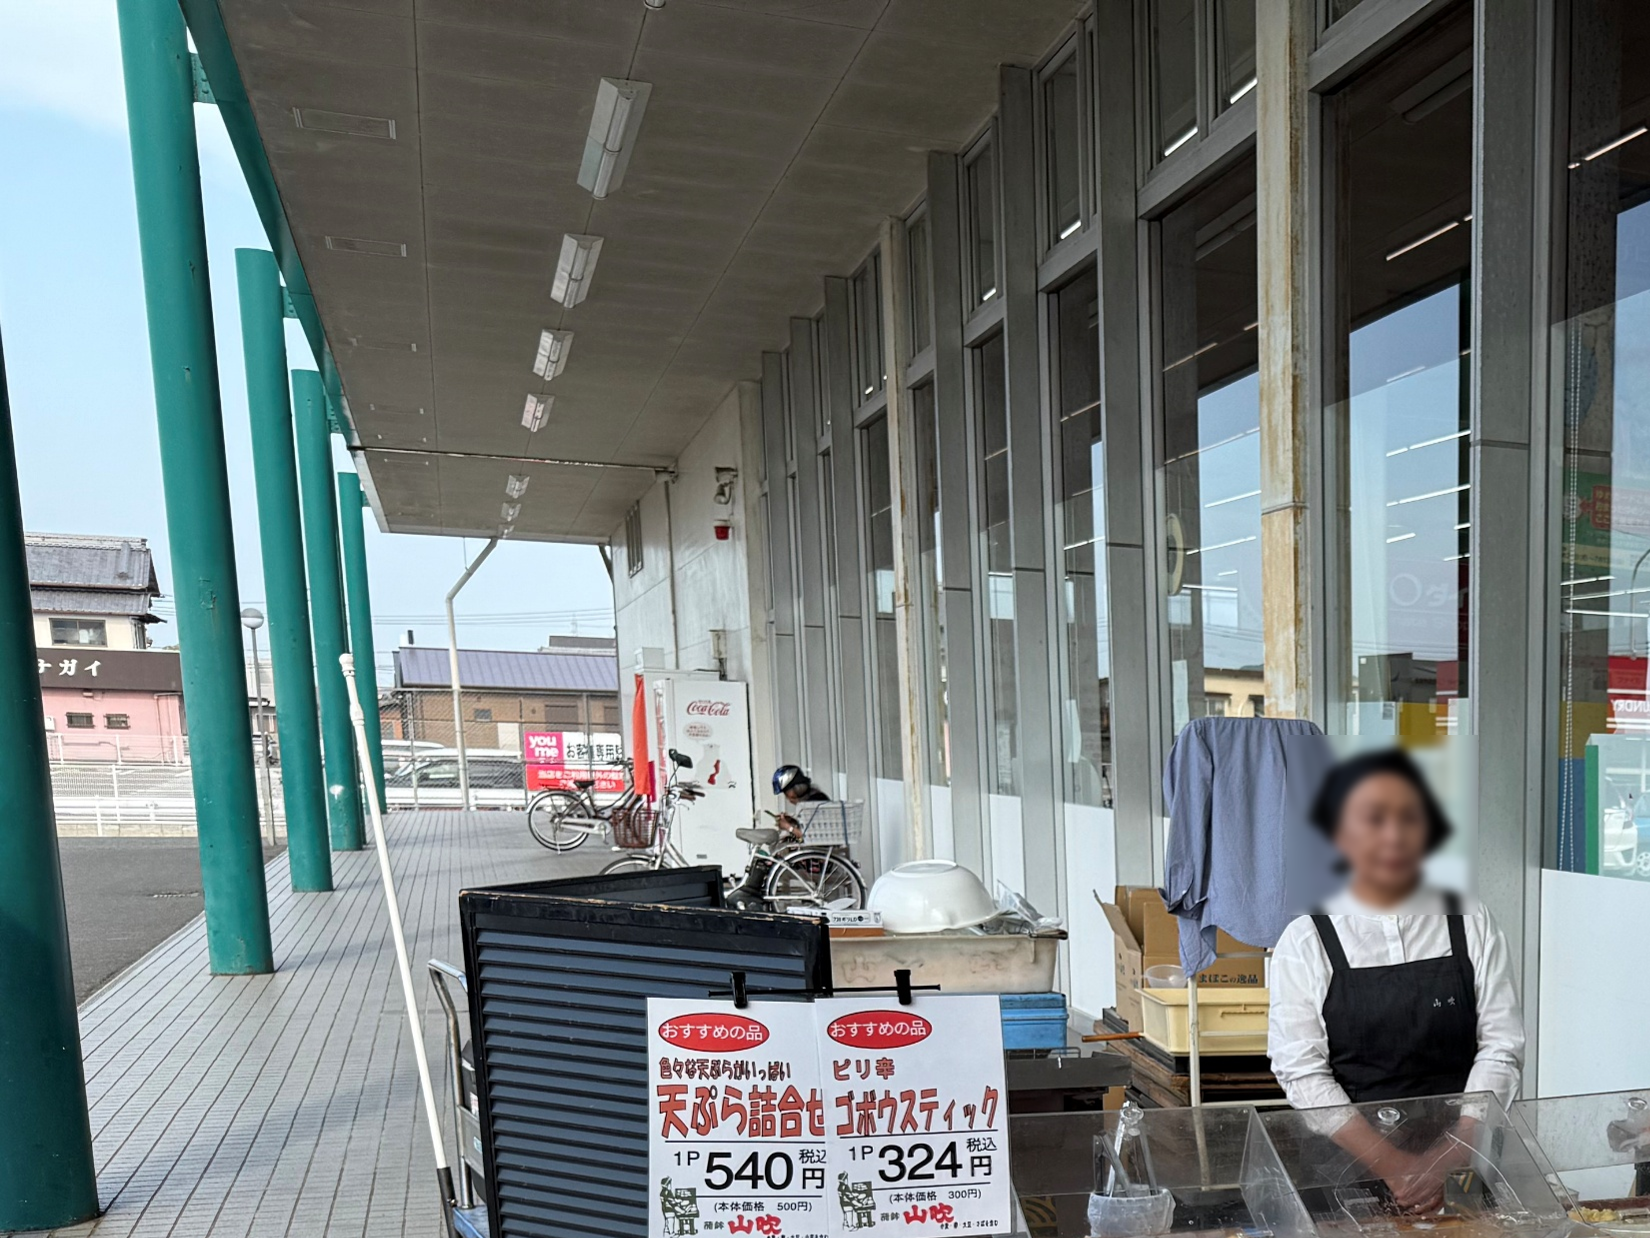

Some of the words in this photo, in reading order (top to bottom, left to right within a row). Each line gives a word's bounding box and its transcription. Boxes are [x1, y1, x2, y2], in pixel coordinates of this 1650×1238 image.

[529, 736, 557, 748] you
[534, 747, 559, 758] me
[662, 1023, 763, 1041] おすすめの品
[830, 1020, 927, 1038] おすすめの品
[659, 1057, 791, 1081] 色々な天ぷらがいっぱい
[833, 1057, 895, 1081] ピリ辛
[657, 1084, 825, 1139] 天ぷら詰合せ
[836, 1085, 999, 1136] ゴボウスティック
[849, 1145, 874, 1161] 1P
[966, 1137, 997, 1152] 税込
[674, 1150, 700, 1166] 1P
[704, 1151, 794, 1190] 540
[802, 1168, 825, 1190] 円
[878, 1141, 963, 1183] 324
[970, 1155, 992, 1177] 円
[948, 1188, 982, 1200] 300円)
[777, 1201, 813, 1213] 500円)
[903, 1202, 955, 1225] 山吹
[728, 1213, 783, 1235] 山吹
